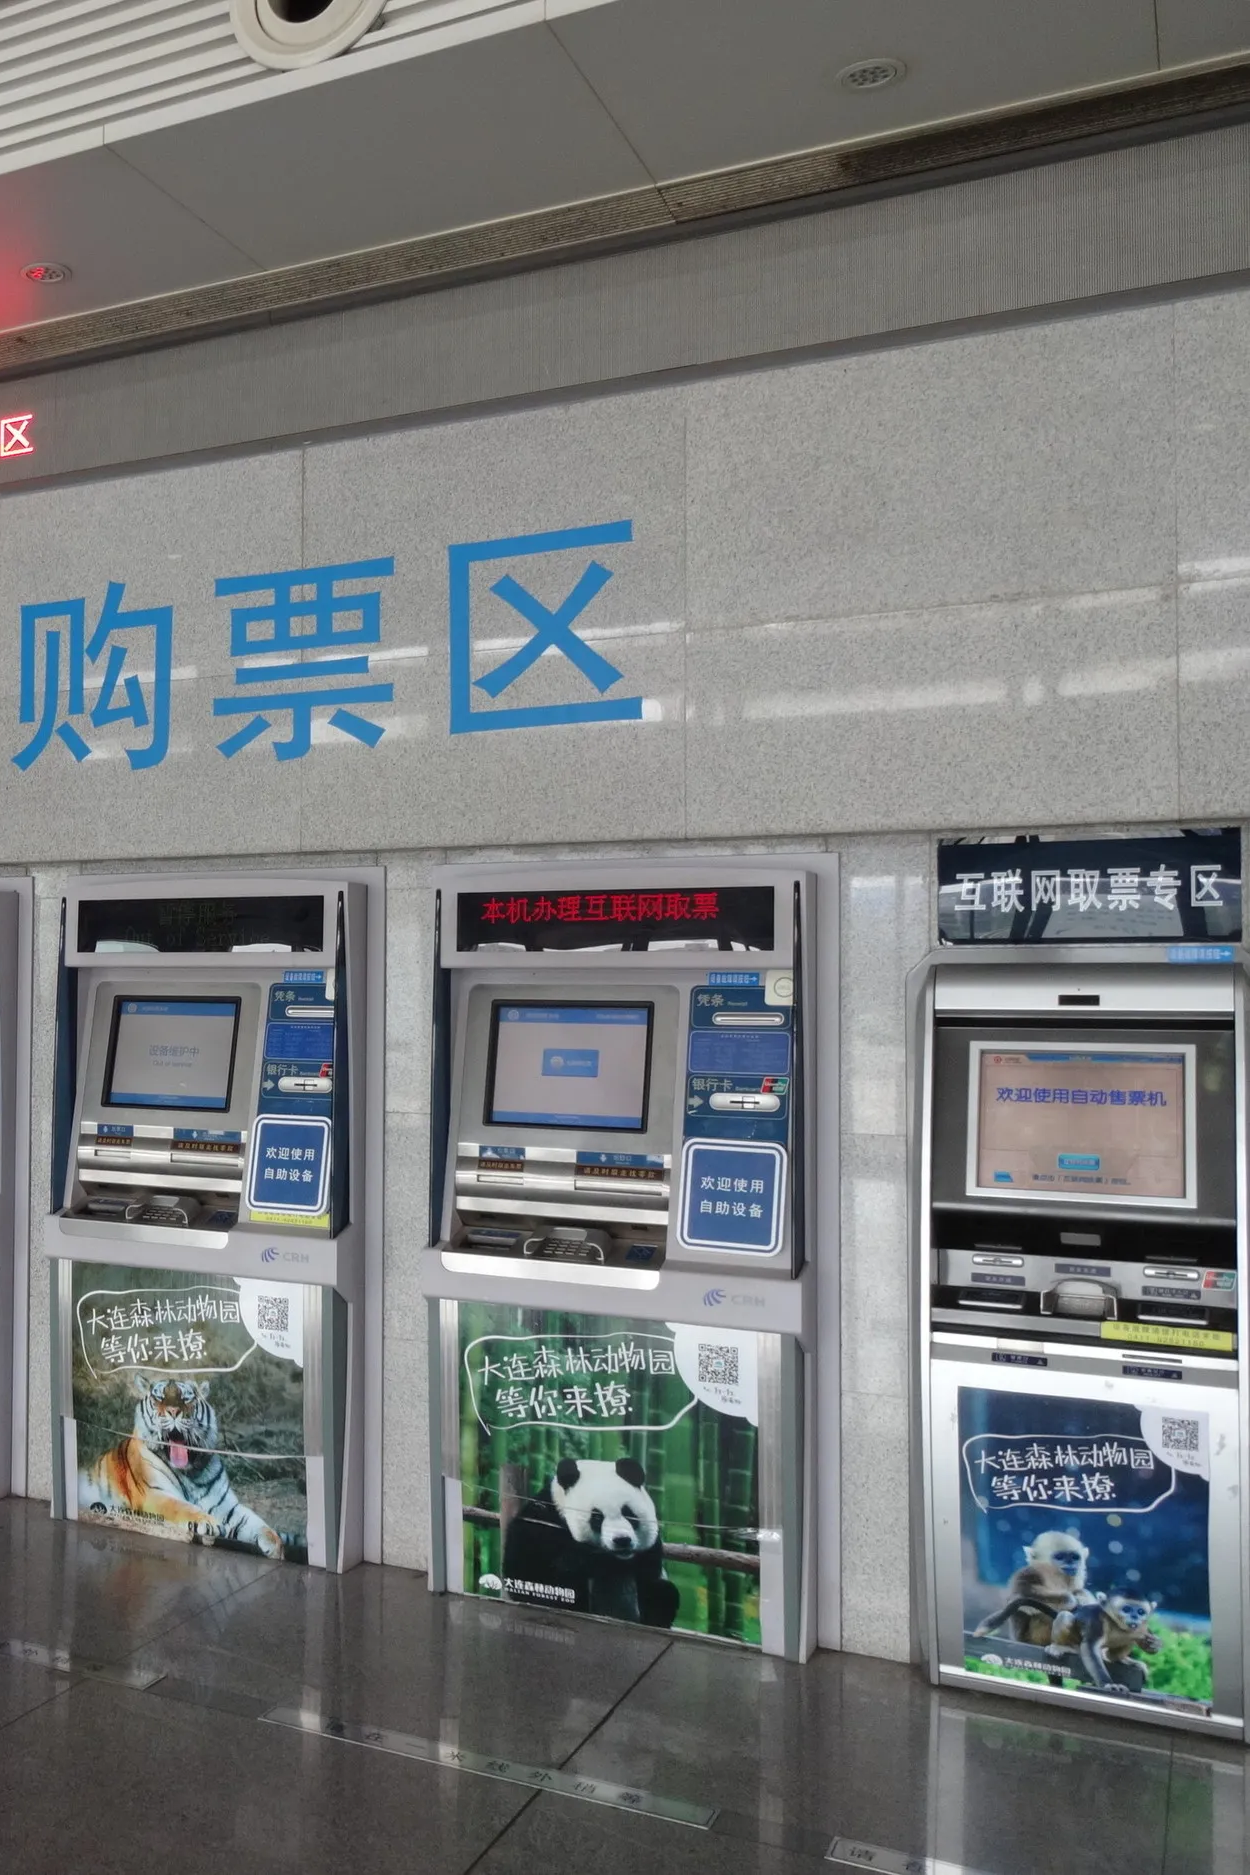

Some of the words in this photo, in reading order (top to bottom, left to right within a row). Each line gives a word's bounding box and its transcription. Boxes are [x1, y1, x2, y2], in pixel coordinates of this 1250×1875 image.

[954, 863, 1223, 913] 互联网取票专区
[480, 891, 720, 925] 本机办理互联网取票
[274, 990, 296, 1002] 凭条
[696, 993, 725, 1007] 凭条
[149, 1044, 200, 1057] 设备维护中
[266, 1063, 299, 1076] 银行卡
[692, 1077, 733, 1092] 银行卡
[996, 1086, 1167, 1107] 欢迎使用自动售票机
[265, 1146, 315, 1161] 欢迎使用
[263, 1168, 314, 1183] 自助设备
[700, 1175, 764, 1194] 欢迎使用
[700, 1199, 764, 1219] 自助设备
[283, 1252, 310, 1263] CRH
[731, 1294, 766, 1307] CRH
[86, 1294, 241, 1335] 大连森林动物园
[100, 1329, 207, 1363] 等你来撩
[477, 1342, 676, 1385] 大连森林动物园
[495, 1381, 633, 1419] 等你来撩
[974, 1441, 1155, 1474] 大连森林动物园
[991, 1472, 1117, 1502] 等你来撩
[504, 1577, 576, 1599] 大连森林动物园
